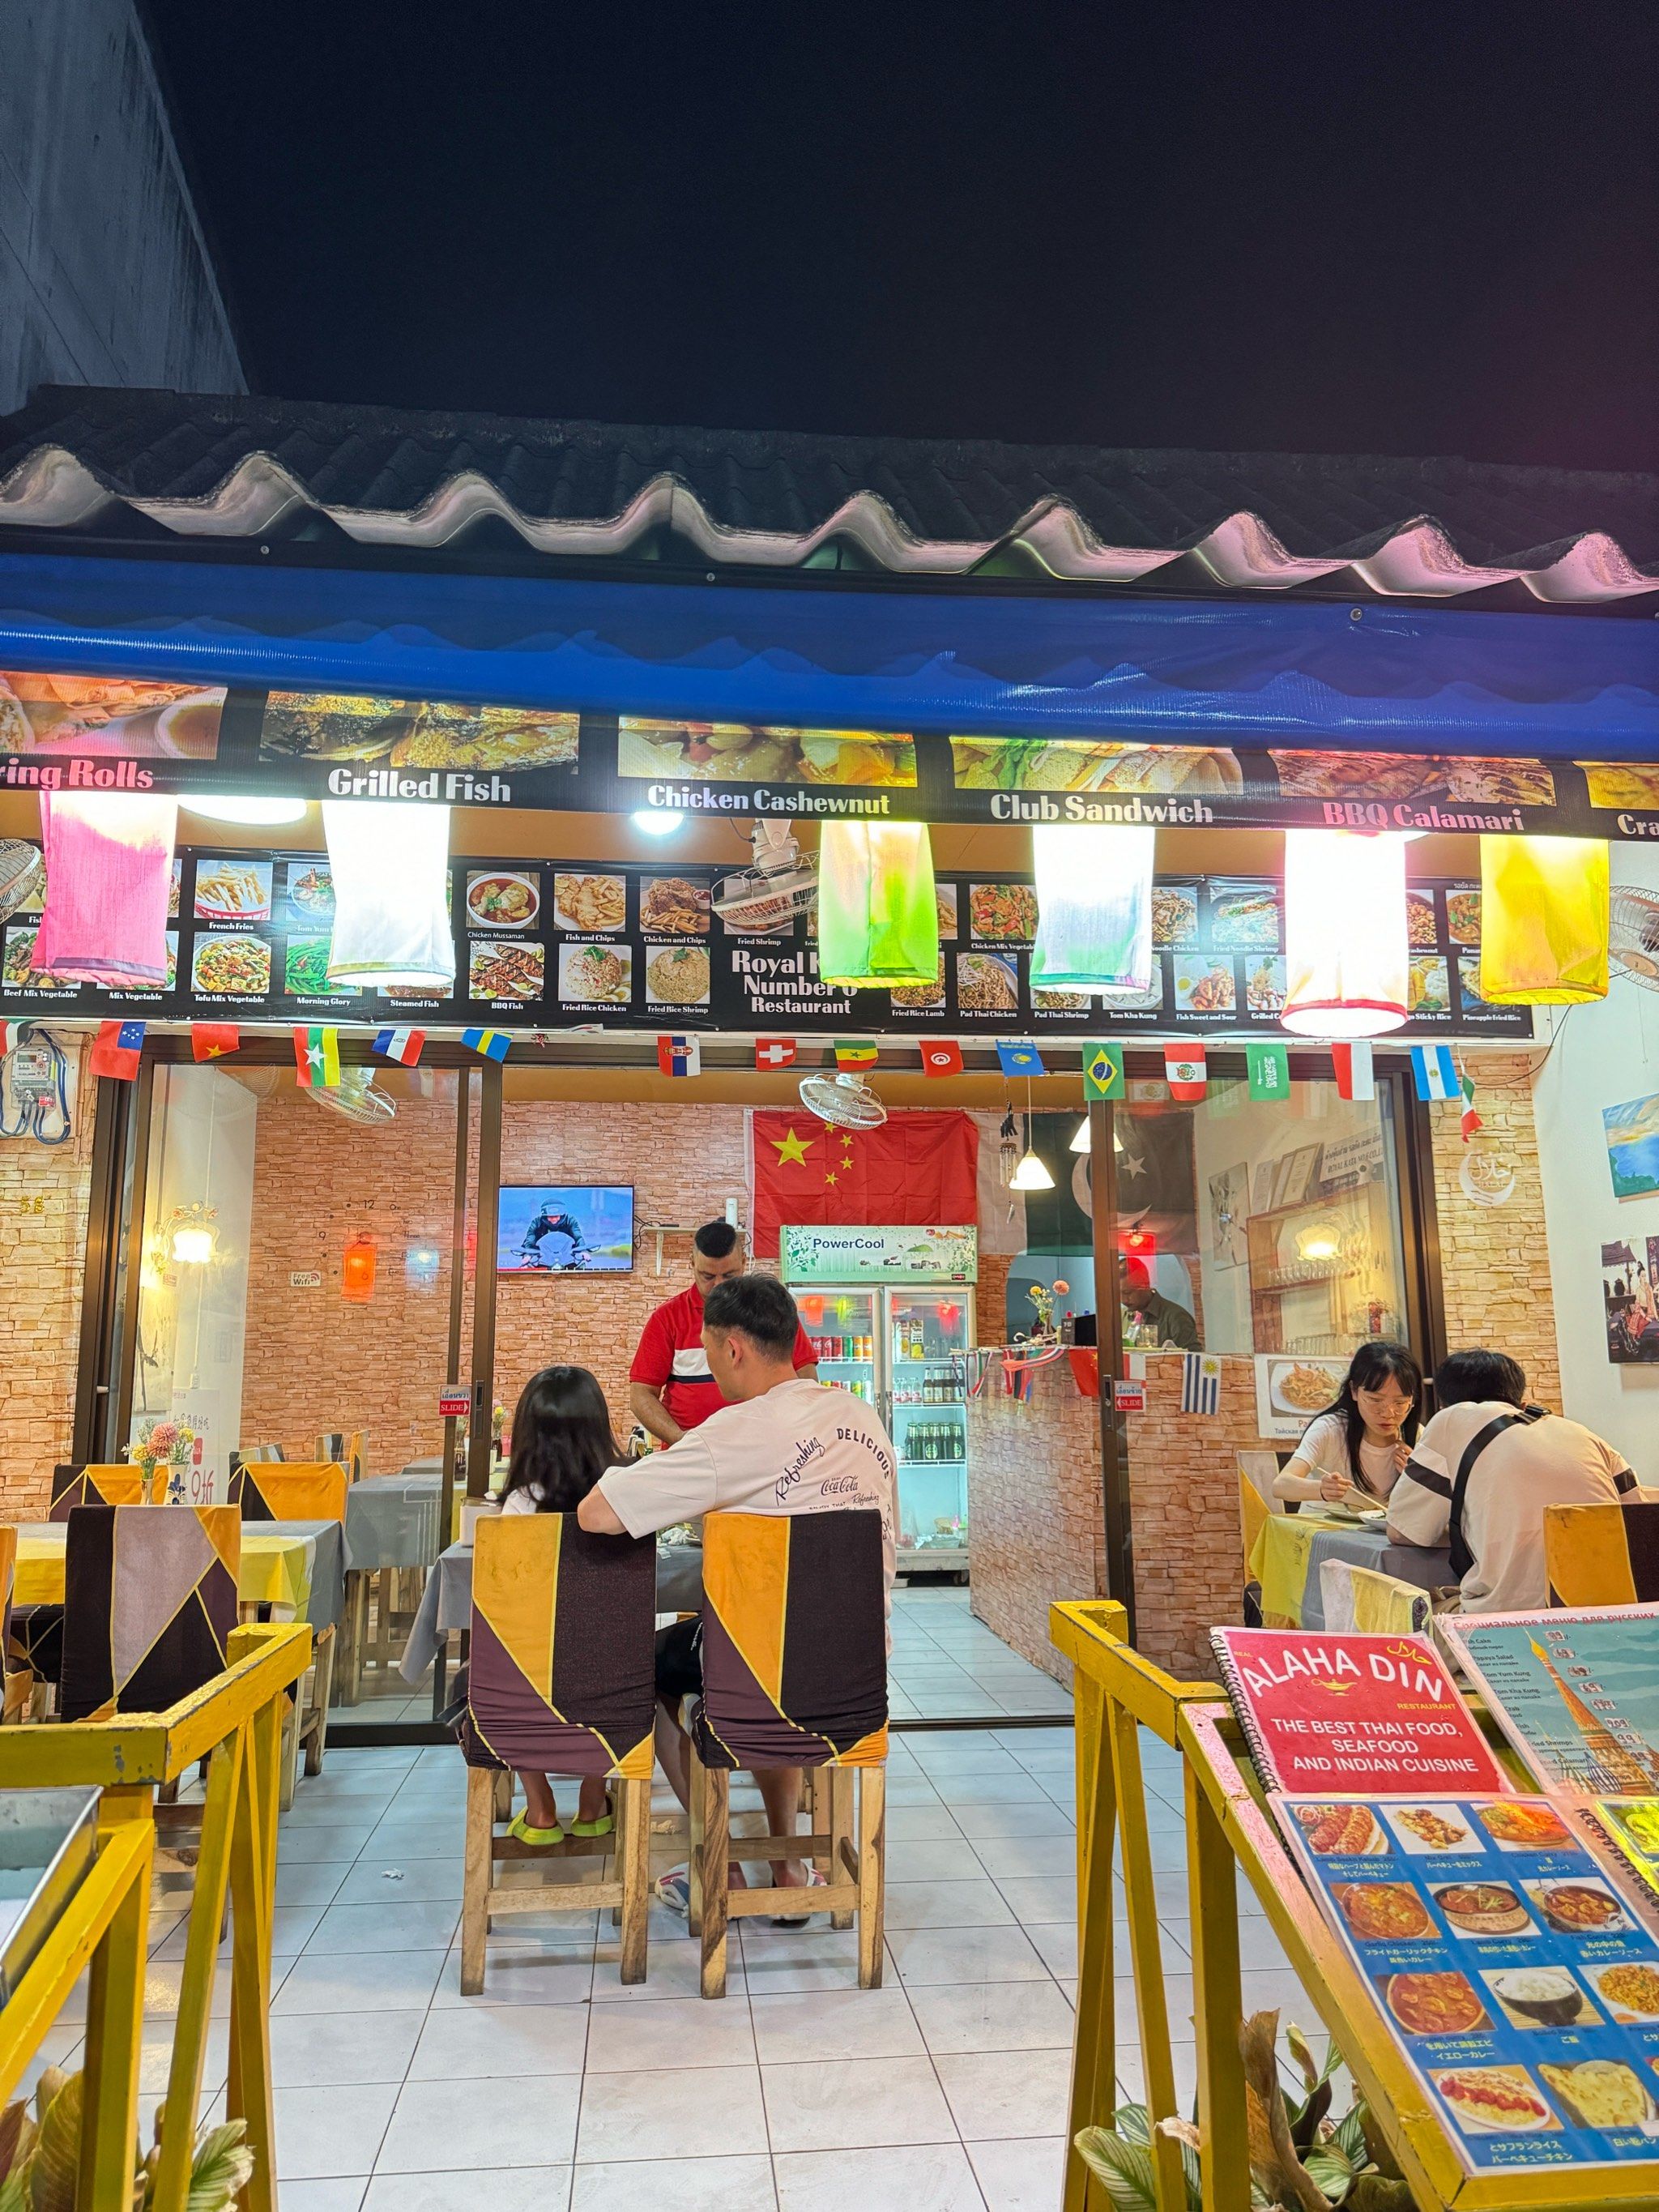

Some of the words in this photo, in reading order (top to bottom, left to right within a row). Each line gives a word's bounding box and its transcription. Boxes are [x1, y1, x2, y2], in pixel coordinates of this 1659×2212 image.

[69, 759, 154, 789] Rolls
[328, 769, 439, 799] Grilled
[446, 774, 510, 802] Fish
[648, 785, 748, 810] Chicken
[753, 789, 889, 814] Cashewnut
[991, 794, 1059, 820] Club
[1065, 796, 1213, 823] Sandwich
[1323, 802, 1388, 830] BBQ
[1393, 805, 1525, 831] Calamari
[209, 922, 234, 930] French
[236, 923, 254, 931] Fries
[756, 938, 781, 946] Shrimp
[732, 950, 804, 978] Royal
[744, 975, 837, 997] Number
[3, 989, 22, 997] Beef
[23, 989, 38, 997] Mix
[40, 990, 78, 999] Vegetable
[125, 993, 163, 1001] Vegetable
[194, 994, 211, 1002] Tofu
[211, 995, 226, 1003] Mix
[227, 996, 265, 1005] Vegetable
[296, 997, 330, 1006] Morning
[330, 997, 351, 1006] Glory
[390, 999, 423, 1007] Steamed
[424, 1000, 440, 1008] Fish
[491, 1001, 507, 1010] BBQ
[509, 1002, 523, 1010] Fish
[598, 1004, 627, 1012] Chicken
[683, 1006, 709, 1014] Shrimp
[751, 997, 851, 1014] Restaurant
[892, 1010, 909, 1018] Fried
[928, 1010, 945, 1018] Lamb
[1064, 1012, 1090, 1020] Shrimp
[1139, 1013, 1158, 1021] Kung
[1251, 1012, 1270, 1020] Grilled
[1415, 1014, 1436, 1023] Sticky
[1462, 1014, 1492, 1023] Pineapple
[364, 1199, 375, 1209] 12
[318, 1232, 326, 1241] 9
[812, 1238, 885, 1249] PowerCool
[775, 1437, 826, 1507] Refreshing
[1542, 1616, 1578, 1626] меню
[1606, 1612, 1657, 1624] русских
[1241, 1646, 1363, 1698] ALAHA
[1367, 1652, 1444, 1702] DIN
[1396, 1702, 1456, 1710] RESTAURANT
[1270, 1718, 1307, 1733] THE
[1309, 1719, 1355, 1735] BEST
[1358, 1721, 1402, 1736] THAI
[1407, 1723, 1463, 1738] FOOD,
[1333, 1739, 1418, 1754] SEAFOOD
[1293, 1756, 1335, 1770] AND
[1337, 1757, 1401, 1772] INDIAN
[1401, 1757, 1479, 1773] CUISINE
